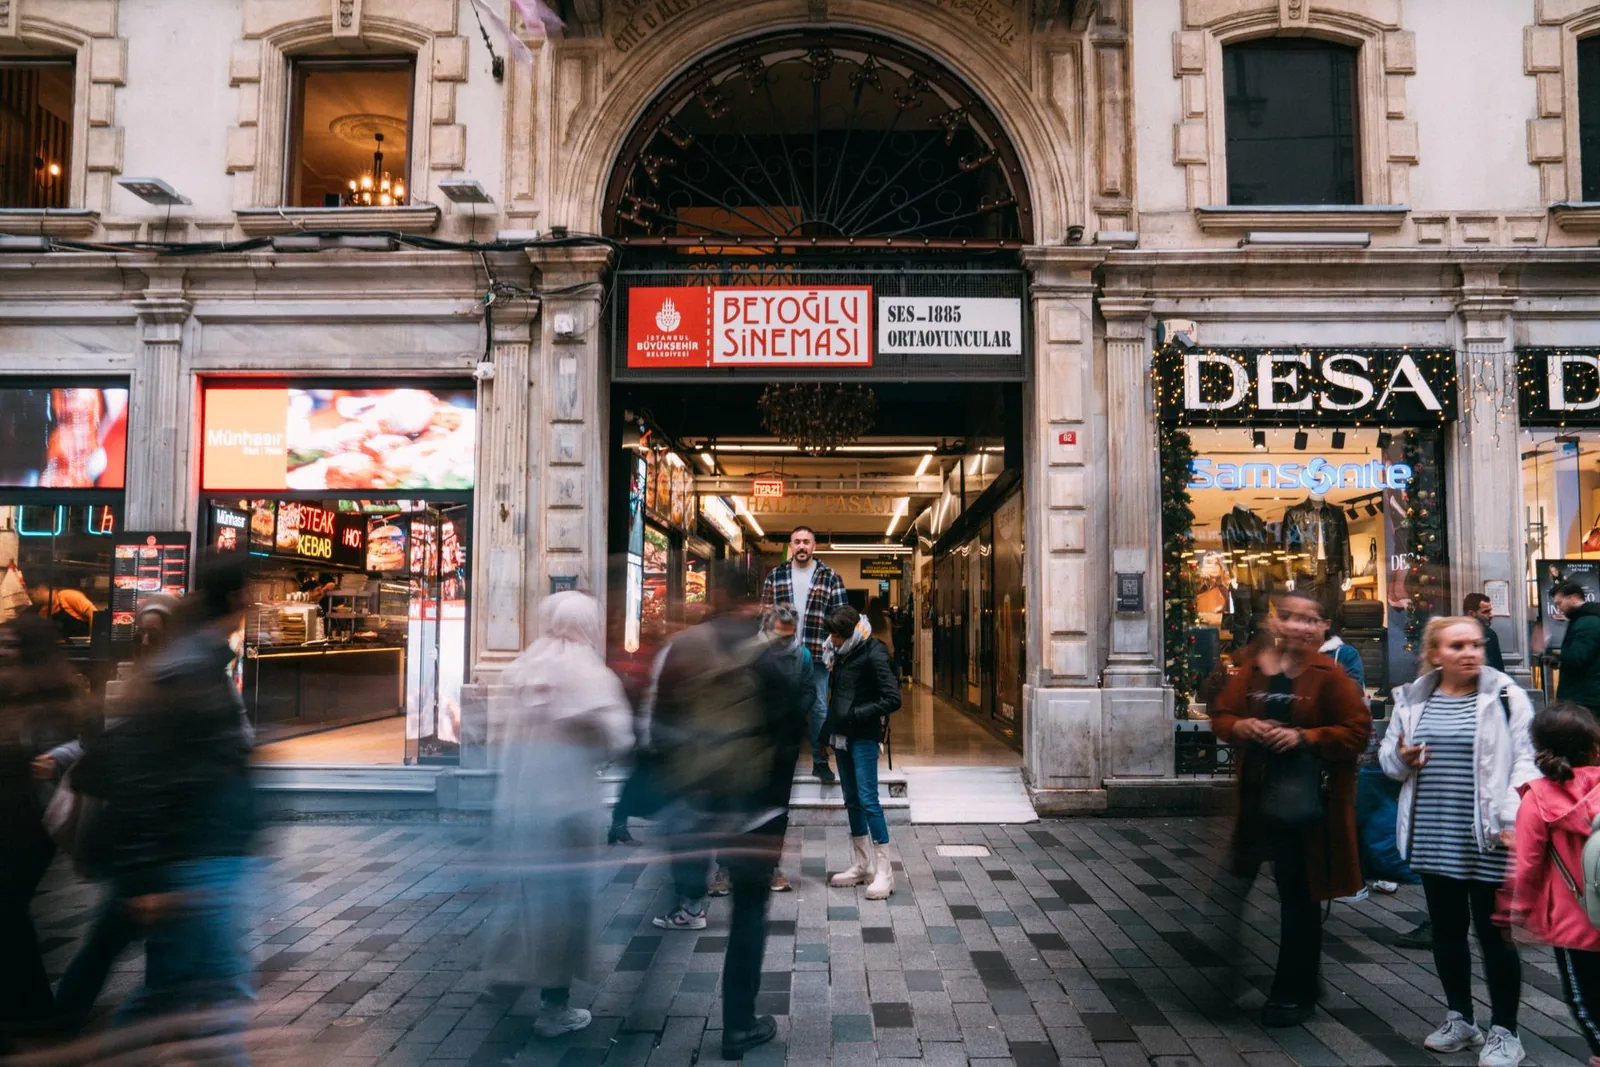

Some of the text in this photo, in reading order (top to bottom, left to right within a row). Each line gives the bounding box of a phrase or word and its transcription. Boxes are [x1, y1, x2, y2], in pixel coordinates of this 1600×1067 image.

[887, 330, 1012, 348] ORTAOYUNCULAR
[1184, 354, 1443, 411] DESA
[1187, 457, 1414, 496] Samsonite
[823, 495, 896, 514] PASAJI
[298, 503, 336, 535] STEAK
[297, 534, 332, 559] KEBAB
